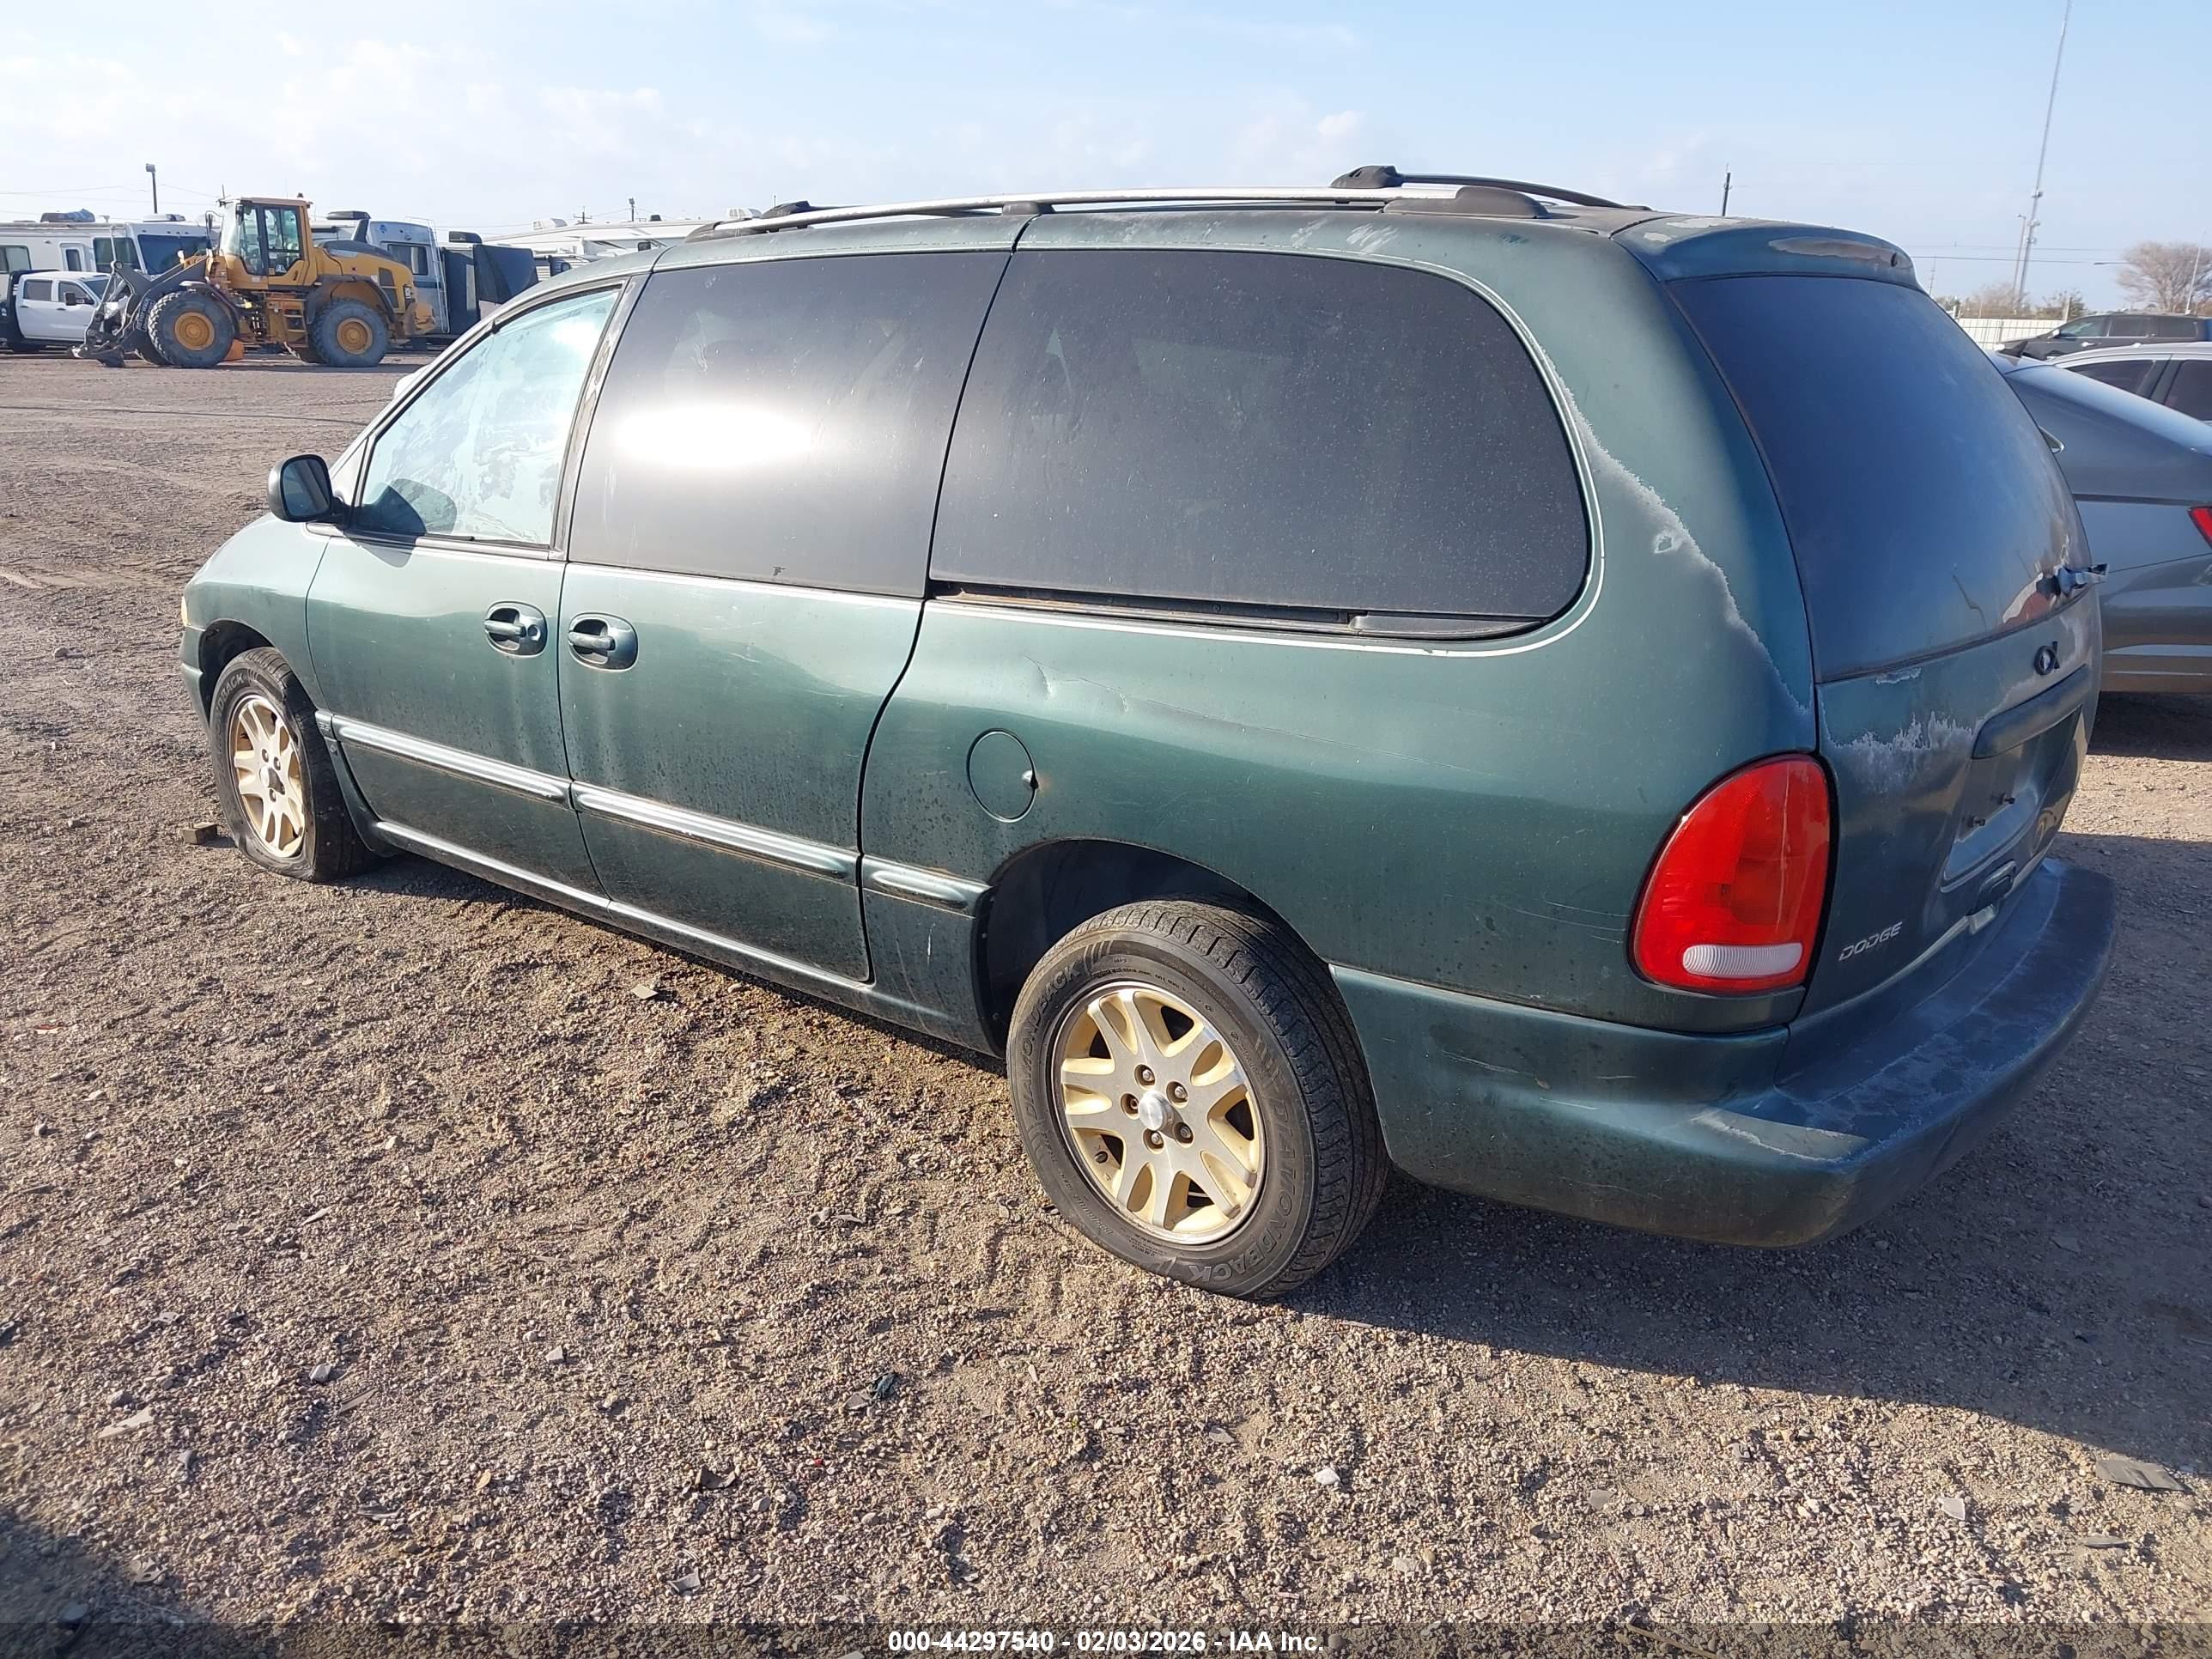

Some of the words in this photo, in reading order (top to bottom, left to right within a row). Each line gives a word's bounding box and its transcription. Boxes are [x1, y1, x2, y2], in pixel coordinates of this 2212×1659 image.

[1838, 921, 1904, 962] DODGE
[1021, 962, 1080, 1121] DIAMONDBACK
[1188, 1095, 1297, 1282] DIAMONDBACK
